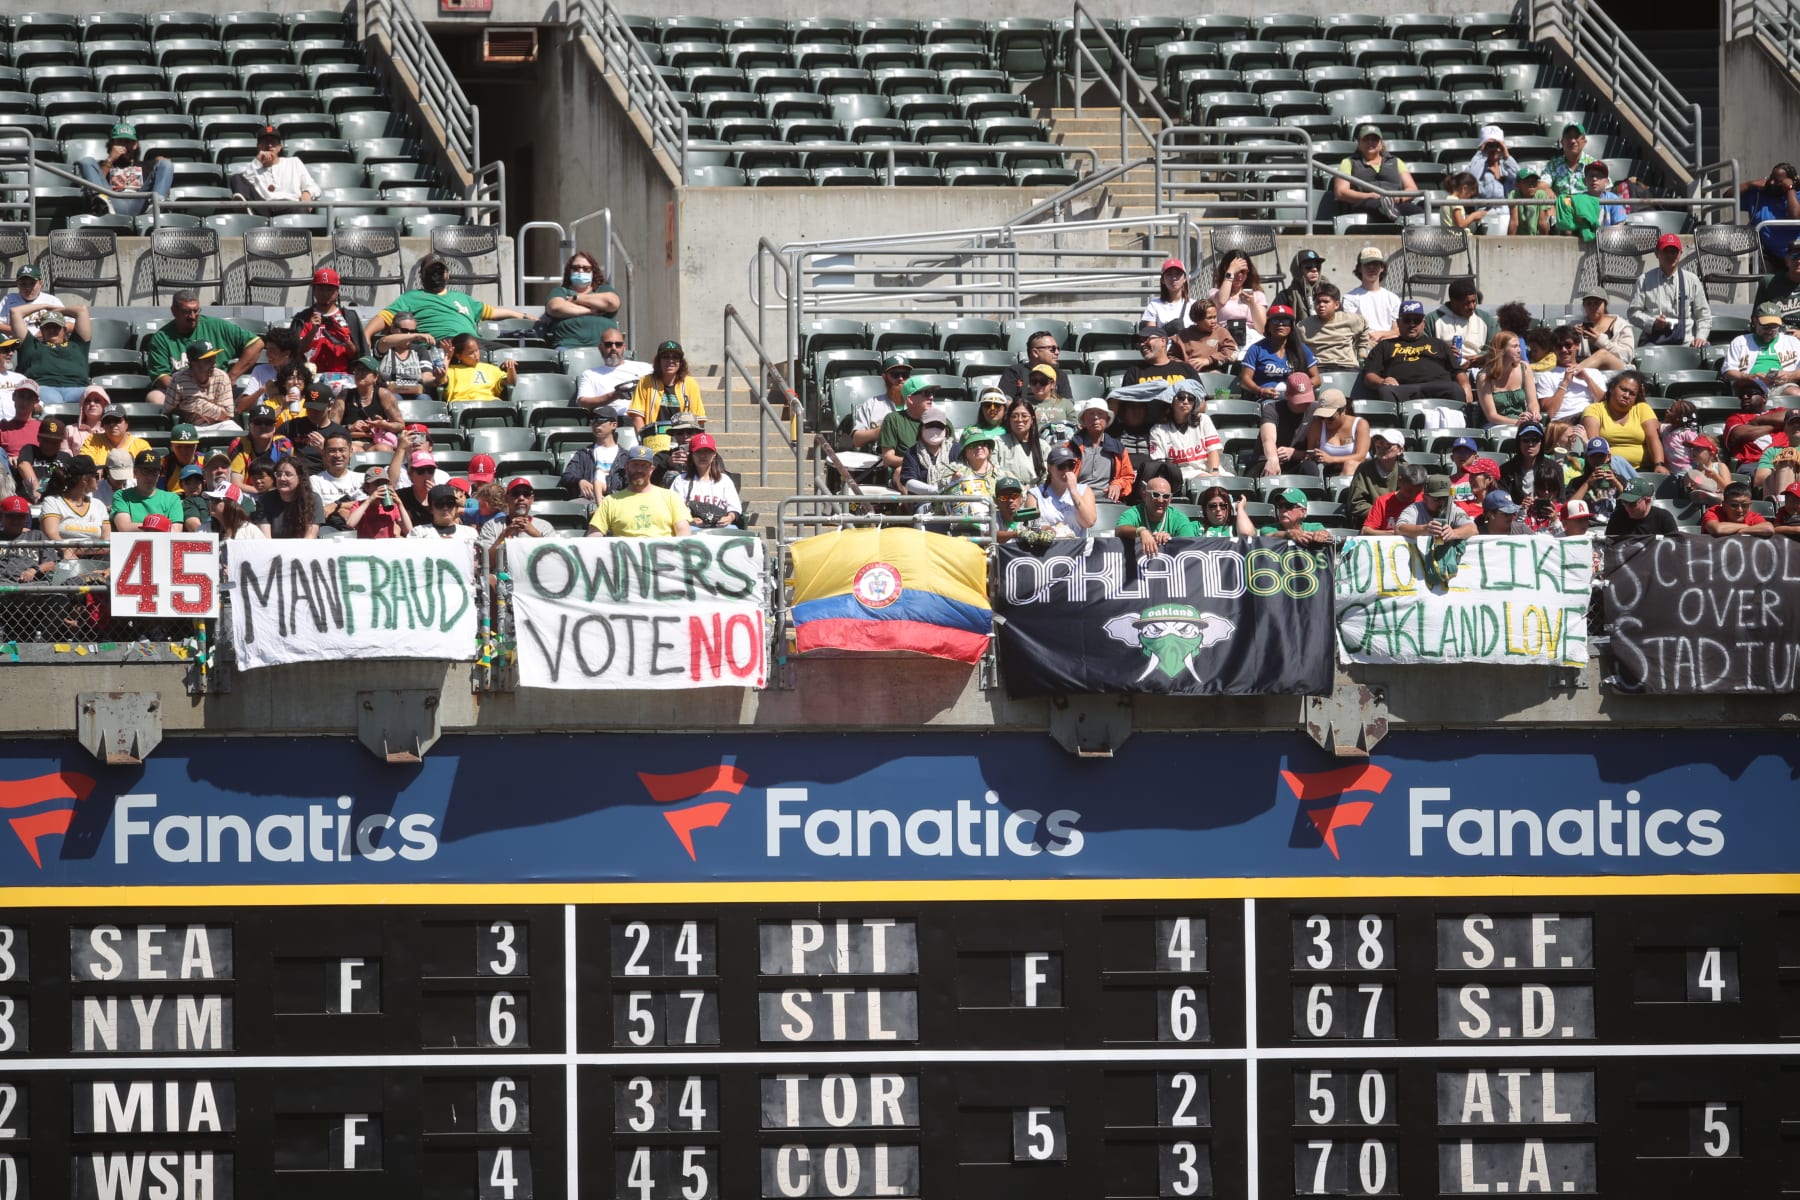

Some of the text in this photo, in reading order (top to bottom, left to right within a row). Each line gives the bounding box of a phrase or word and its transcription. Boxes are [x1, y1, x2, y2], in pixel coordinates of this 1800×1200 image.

[1168, 438, 1208, 460] Angel
[115, 539, 213, 616] 45
[527, 537, 756, 602] OWNERS
[1479, 539, 1590, 594] LIKE
[1610, 538, 1800, 610] SCHOOL
[240, 554, 469, 645] MANFRAUD
[1679, 588, 1784, 626] OVER
[524, 610, 764, 686] VOTE NO!
[1336, 599, 1587, 667] OAKLAND LOVE
[115, 794, 438, 864] Fanatics
[766, 787, 1085, 858] Fanatics
[1408, 787, 1724, 857] Fanatics
[90, 925, 215, 980] SEA
[490, 921, 517, 975] 3
[792, 919, 896, 973] PIT
[1168, 916, 1195, 972] 4
[1462, 914, 1573, 968] S.F.
[340, 958, 365, 1013] F
[1025, 952, 1049, 1006] F
[1698, 947, 1726, 1001] 4
[84, 995, 222, 1050] NYM
[489, 991, 516, 1046] 6
[780, 988, 897, 1040] STL
[1170, 985, 1197, 1041] 6
[1459, 984, 1573, 1038] S.D.
[93, 1080, 222, 1133] MIA
[490, 1077, 517, 1132] 6
[776, 1073, 905, 1127] TOR
[1171, 1071, 1197, 1127] 2
[1461, 1069, 1572, 1123] ATL
[343, 1114, 369, 1169] F
[1028, 1107, 1054, 1160] 5
[1704, 1103, 1730, 1157] 5
[92, 1151, 214, 1200] WSH
[490, 1147, 519, 1199] 4
[776, 1143, 904, 1197] COL
[1172, 1140, 1199, 1196] 3
[1460, 1138, 1576, 1193] L.A.
